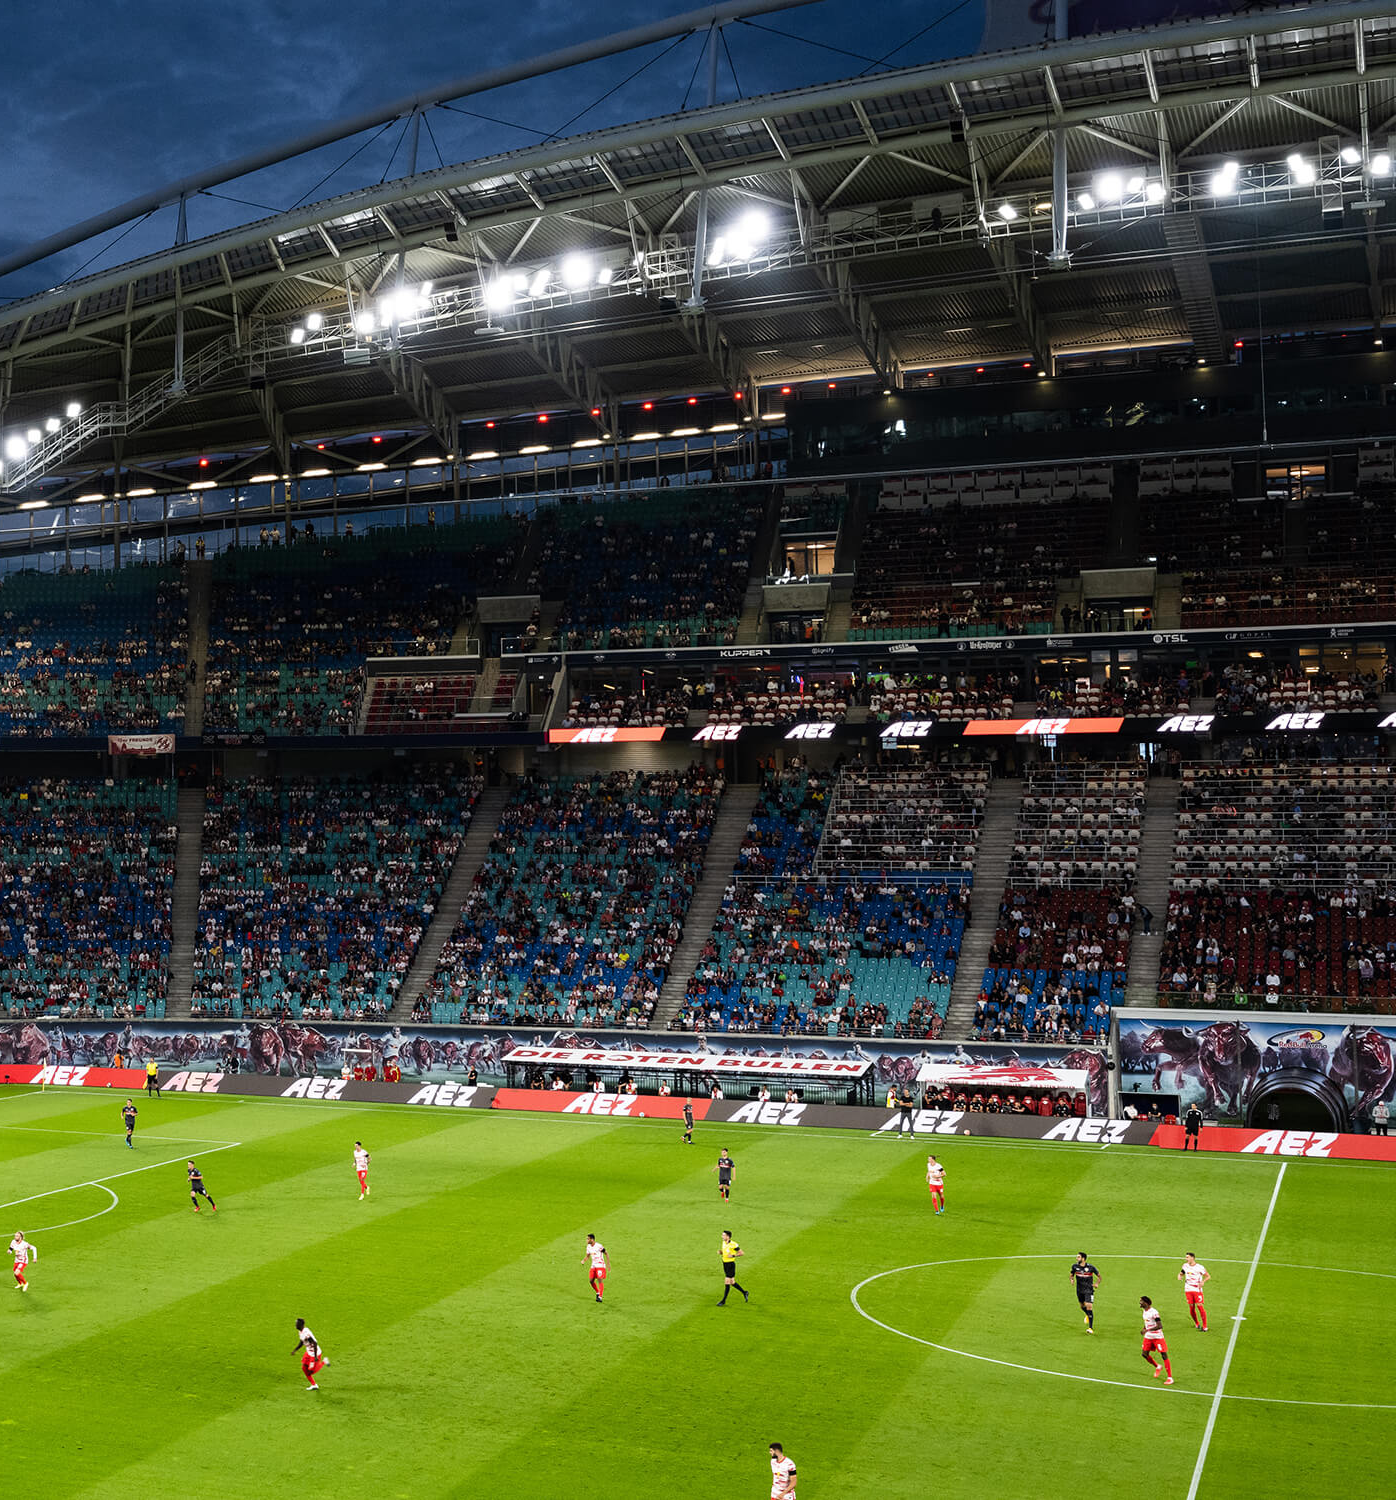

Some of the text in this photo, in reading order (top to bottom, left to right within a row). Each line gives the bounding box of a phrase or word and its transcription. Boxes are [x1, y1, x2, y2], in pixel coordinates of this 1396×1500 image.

[784, 723, 836, 739] AEZ
[879, 721, 932, 737] AEZ
[1015, 718, 1070, 734] AEZ
[1156, 715, 1215, 732] AEZ
[1265, 712, 1325, 730] AEZ
[570, 728, 618, 742] AEZ
[692, 725, 742, 740] AEZ
[512, 1050, 572, 1060] DIE
[717, 1059, 862, 1072] BULLEN
[29, 1066, 91, 1086] AEZ
[161, 1071, 225, 1092] AEZ
[281, 1077, 347, 1100] AEZ
[407, 1084, 478, 1107] AEZ
[562, 1092, 638, 1116] AEZ
[727, 1101, 808, 1126] AEZ
[1041, 1117, 1132, 1144] AEZ
[1240, 1130, 1339, 1157] AEZ
